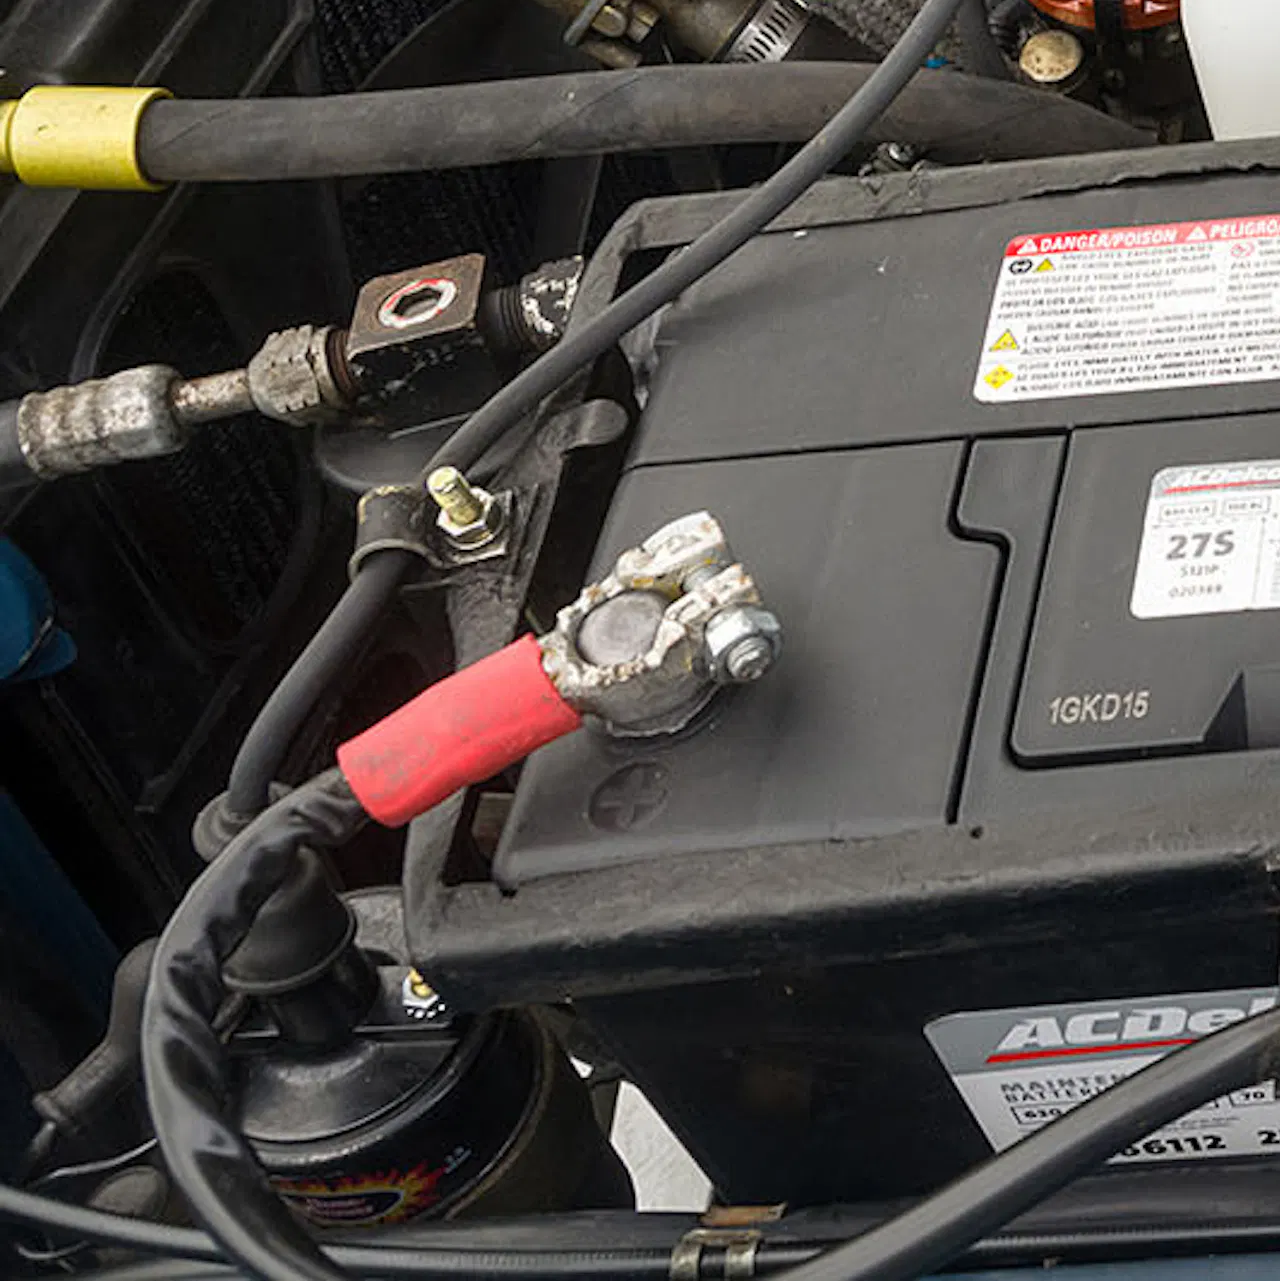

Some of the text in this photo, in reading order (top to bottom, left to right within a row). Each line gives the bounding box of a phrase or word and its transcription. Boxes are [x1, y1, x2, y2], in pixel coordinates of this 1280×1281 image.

[1040, 229, 1178, 253] DANGER/POISON
[1165, 528, 1236, 562] 27S
[1048, 690, 1151, 726] 1GKD15
